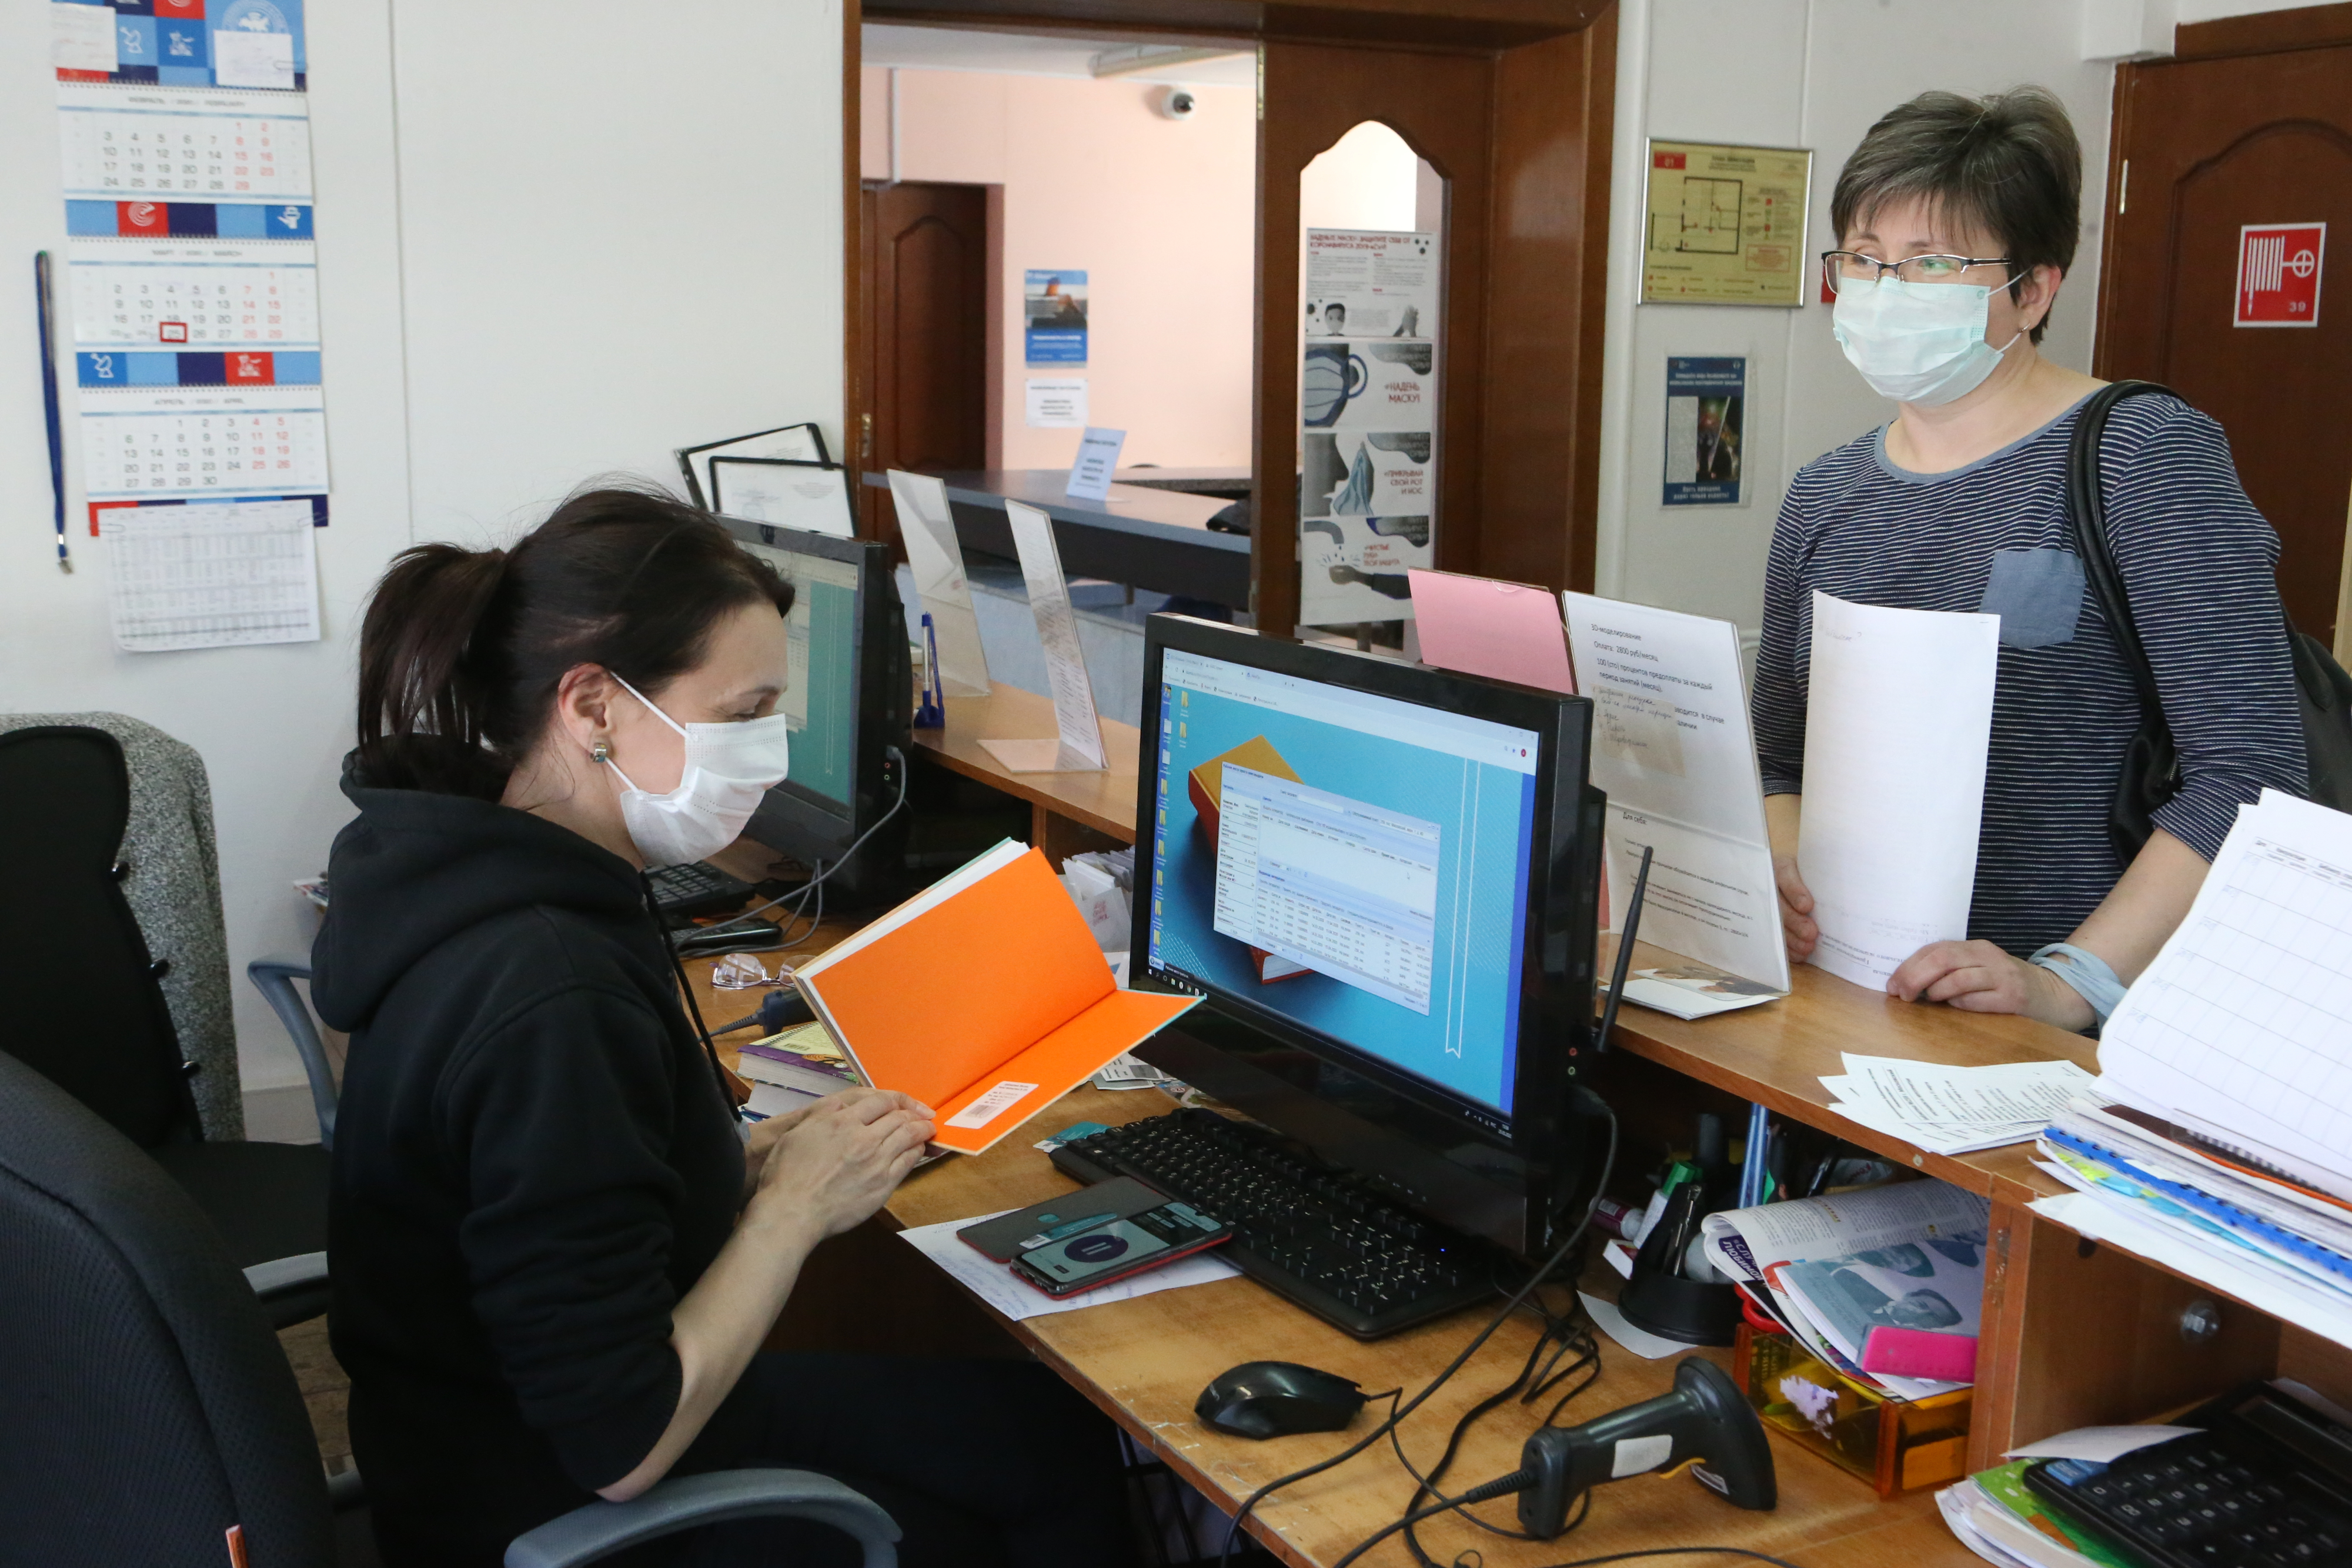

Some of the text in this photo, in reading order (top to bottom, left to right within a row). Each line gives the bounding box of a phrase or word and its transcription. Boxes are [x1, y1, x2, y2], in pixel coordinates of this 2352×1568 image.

[2288, 300, 2306, 312] 39
[1591, 624, 1642, 641] 3D-моделирование
[1594, 641, 1659, 663] Оплата: 2800 руб/месяц
[1597, 658, 1606, 666] 100
[1607, 660, 1620, 670] (сто)
[1620, 664, 1648, 676] процентов
[1649, 671, 1682, 684] предоплаты
[1690, 681, 1713, 691] каждый
[1599, 671, 1619, 683] период
[1619, 675, 1640, 686] занятий
[1674, 707, 1699, 717] зводится
[1706, 714, 1725, 724] случае
[1677, 720, 1698, 730] аличии
[1623, 812, 1647, 825] Для себя:
